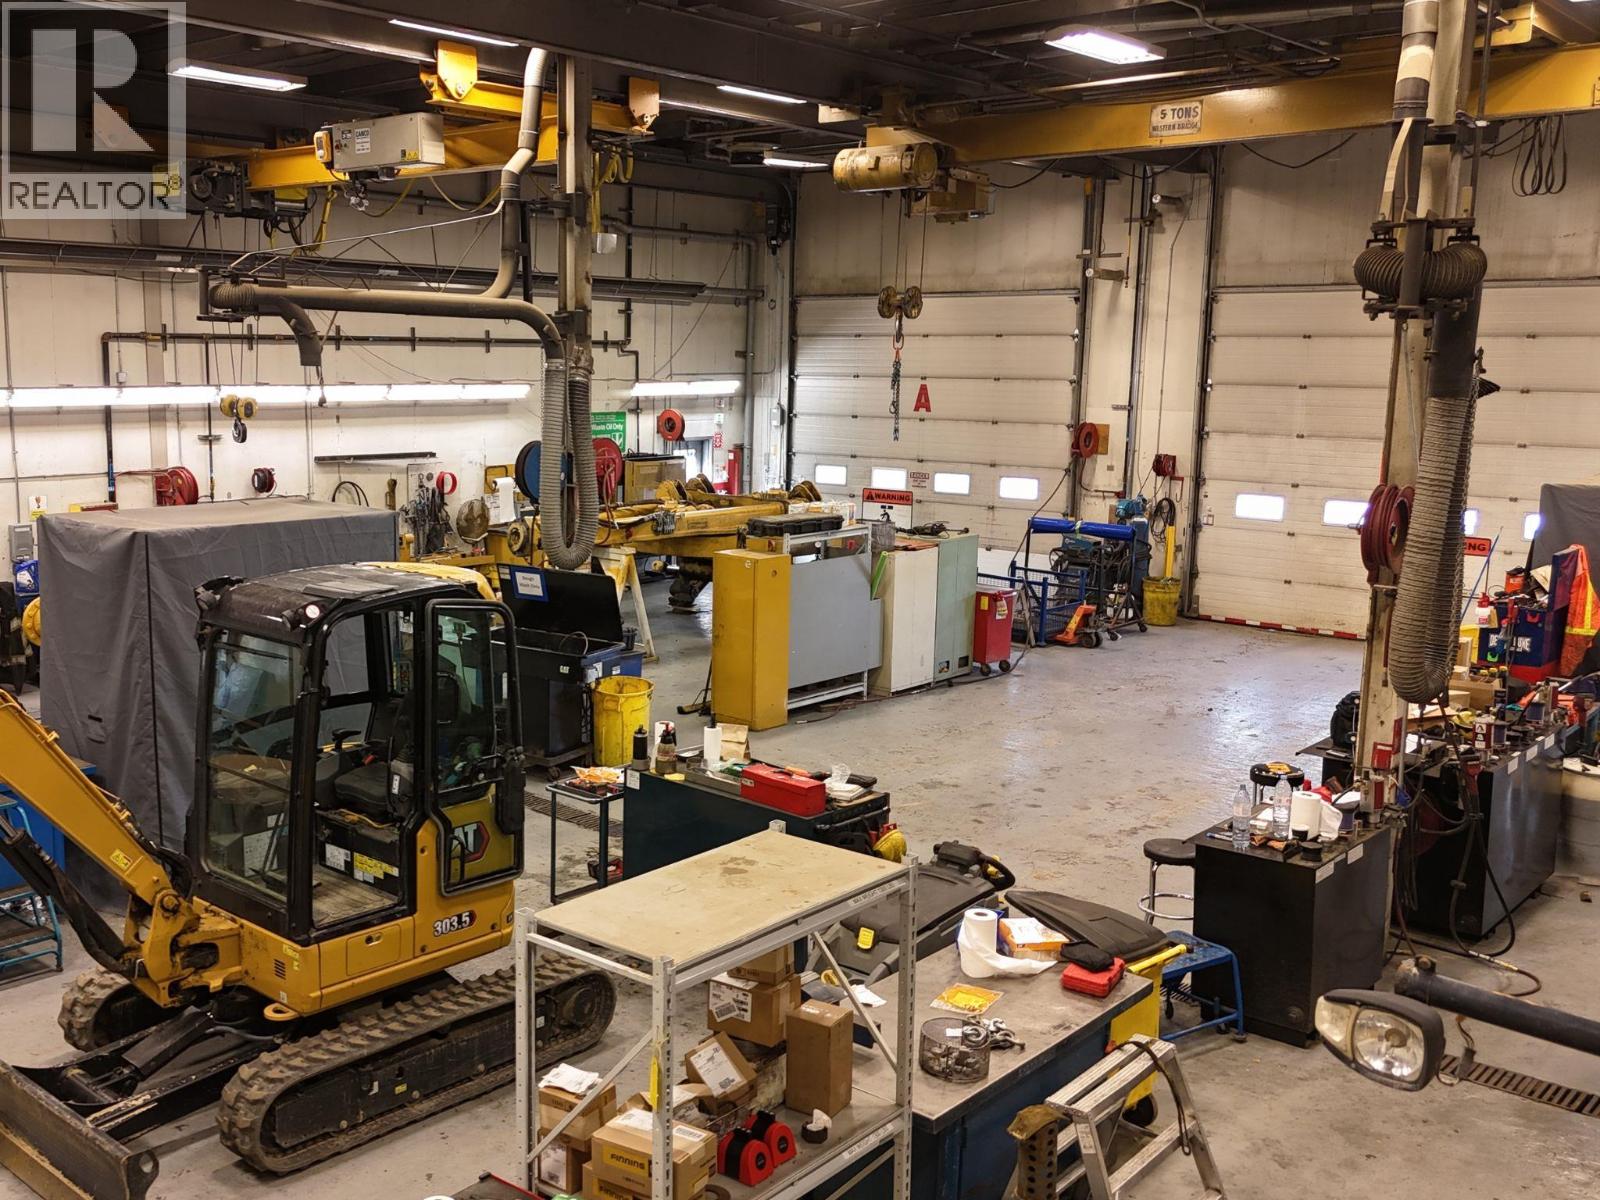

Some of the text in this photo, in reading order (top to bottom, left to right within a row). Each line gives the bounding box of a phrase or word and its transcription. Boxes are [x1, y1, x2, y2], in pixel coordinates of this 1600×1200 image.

[1160, 105, 1199, 120] 5 TONS
[913, 383, 932, 412] A
[874, 491, 911, 502] WARNING
[452, 823, 478, 853] AT
[434, 911, 471, 937] 303.5
